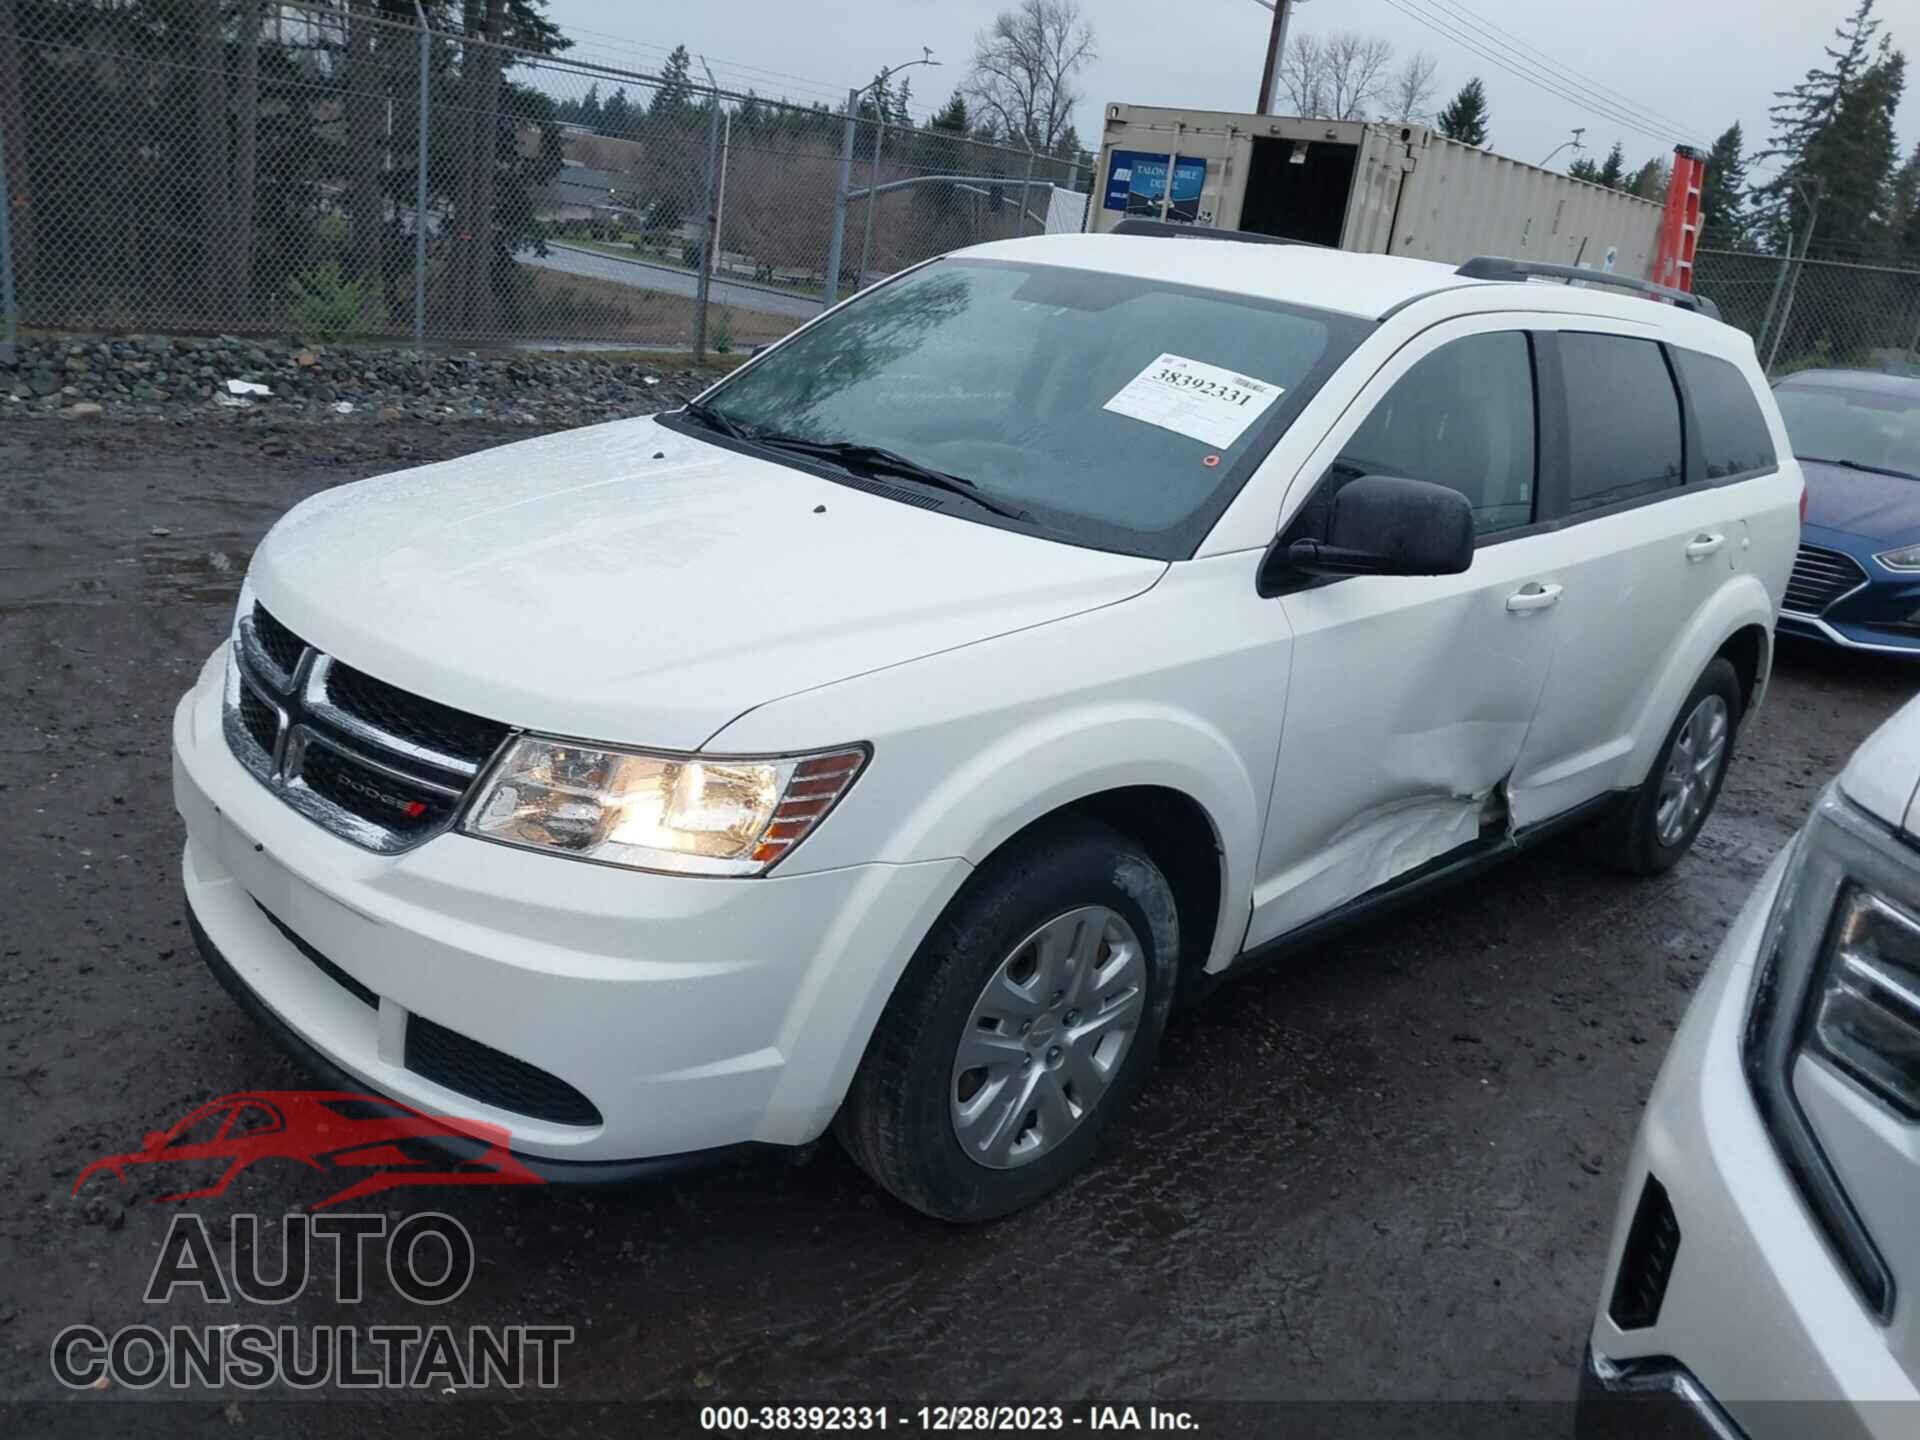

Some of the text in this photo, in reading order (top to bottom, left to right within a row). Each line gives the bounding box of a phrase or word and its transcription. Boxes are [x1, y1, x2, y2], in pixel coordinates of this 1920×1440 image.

[1137, 165, 1165, 175] TALON
[1153, 369, 1253, 406] 38392331
[338, 774, 408, 810] DODGE
